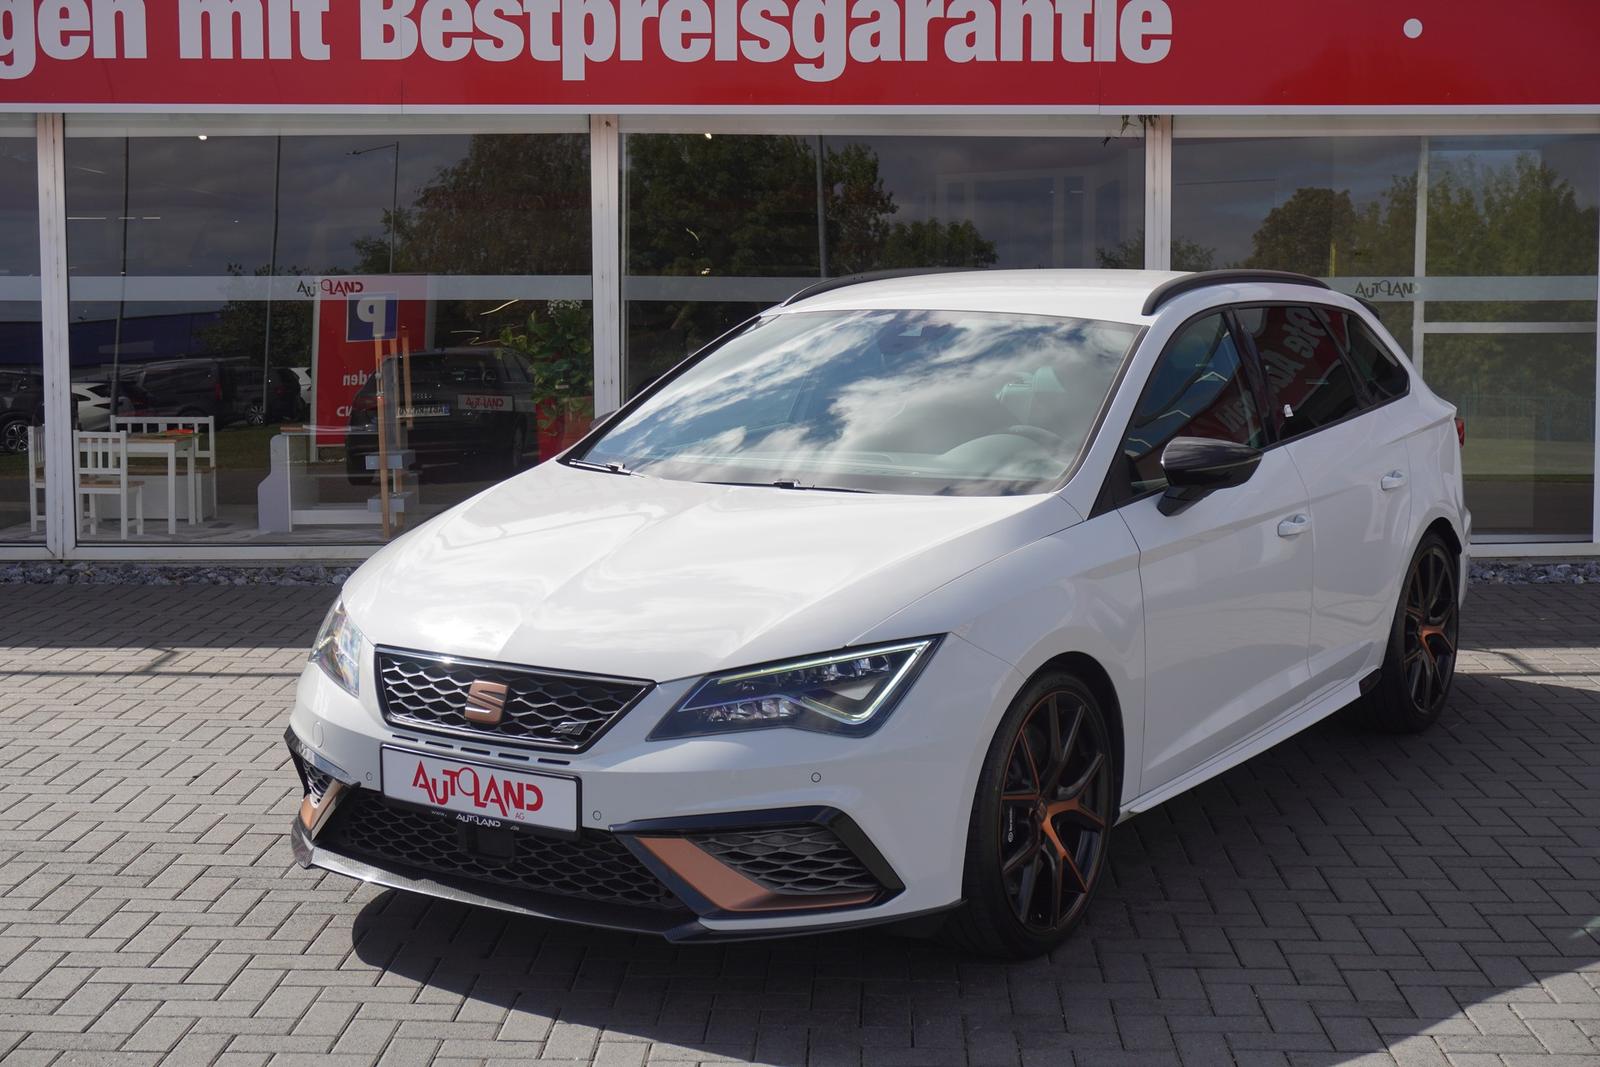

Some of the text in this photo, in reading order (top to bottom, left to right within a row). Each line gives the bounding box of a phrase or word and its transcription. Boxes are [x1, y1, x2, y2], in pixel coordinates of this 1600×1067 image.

[179, 0, 331, 60] mit
[360, 0, 1173, 83] Bestpreisgarantie
[412, 760, 544, 817] AUTOLAND
